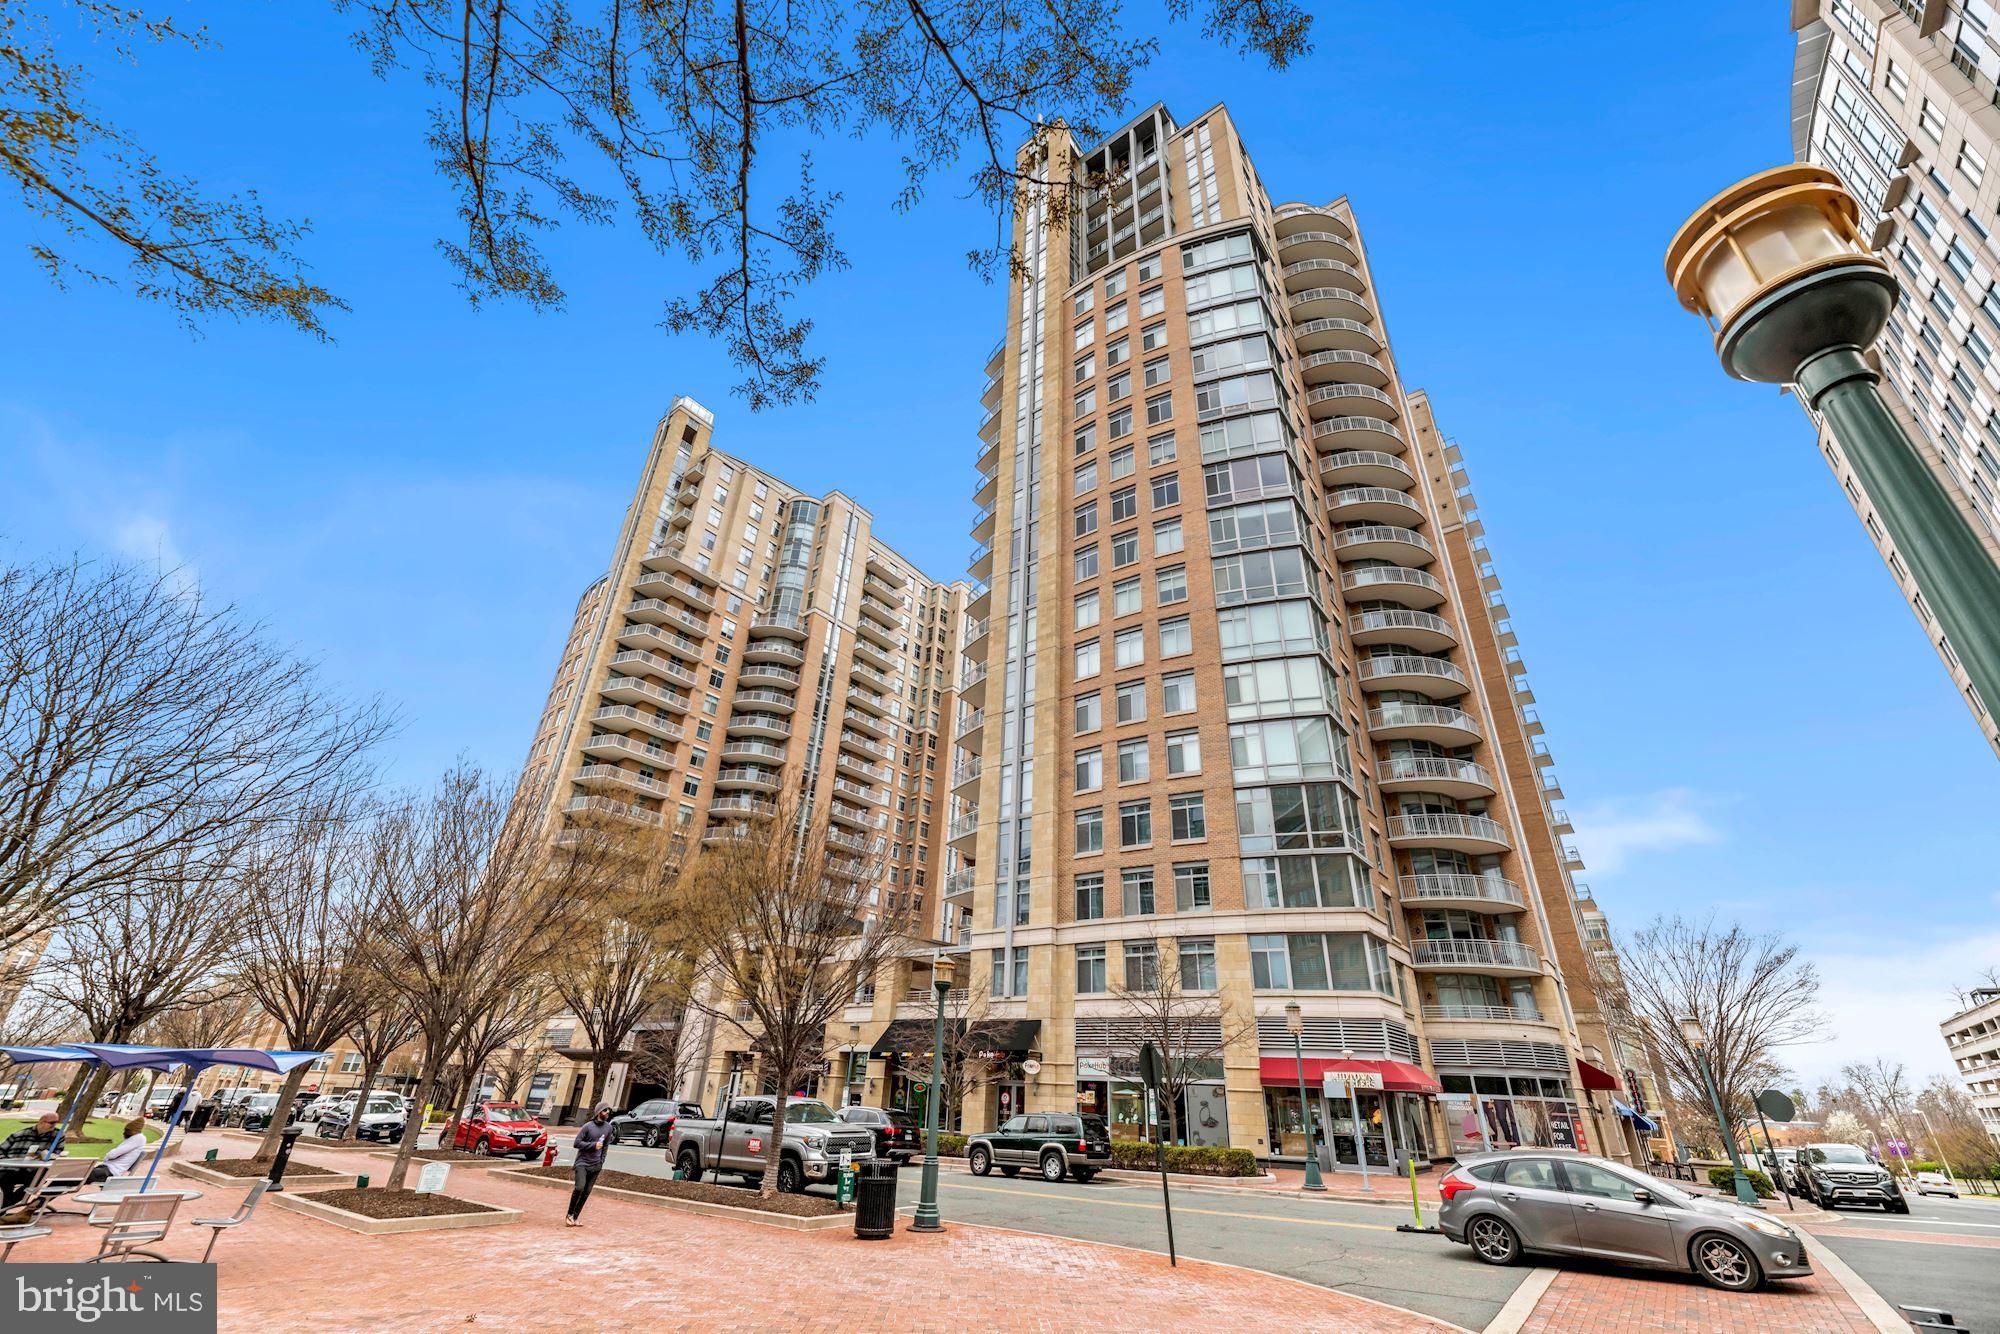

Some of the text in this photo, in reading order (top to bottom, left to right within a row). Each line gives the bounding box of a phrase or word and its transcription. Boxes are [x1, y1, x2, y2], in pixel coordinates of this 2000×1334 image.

[1331, 1072, 1374, 1081] MIDTOWN
[1551, 1121, 1570, 1130] RETAIL
[1553, 1132, 1565, 1141] FOR
